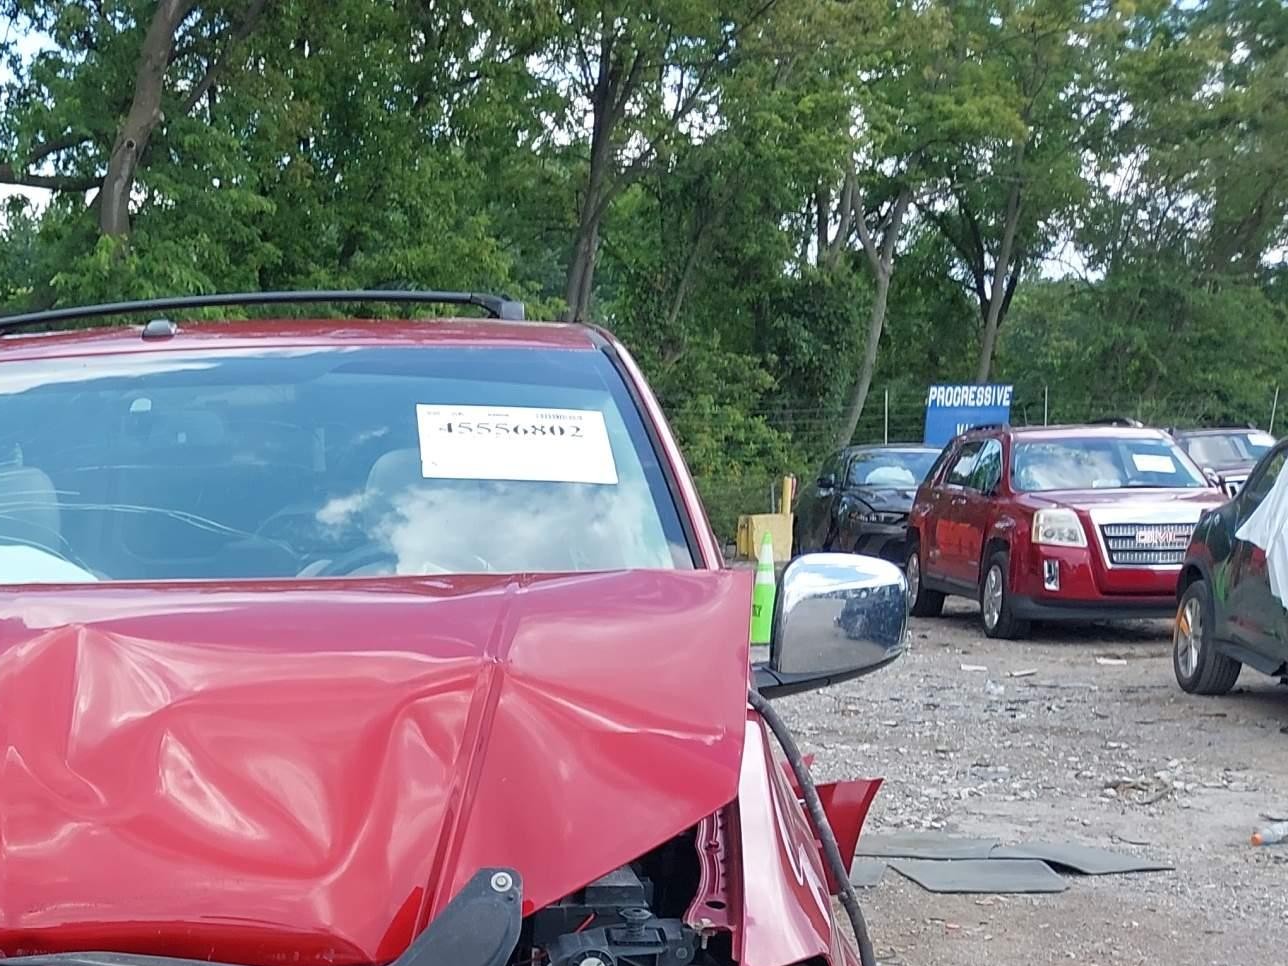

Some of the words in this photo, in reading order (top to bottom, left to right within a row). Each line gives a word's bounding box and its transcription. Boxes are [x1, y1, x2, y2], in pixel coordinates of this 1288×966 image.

[927, 385, 1014, 408] PROGRESSIVE
[437, 421, 584, 439] 45556802
[1135, 530, 1190, 545] GMC
